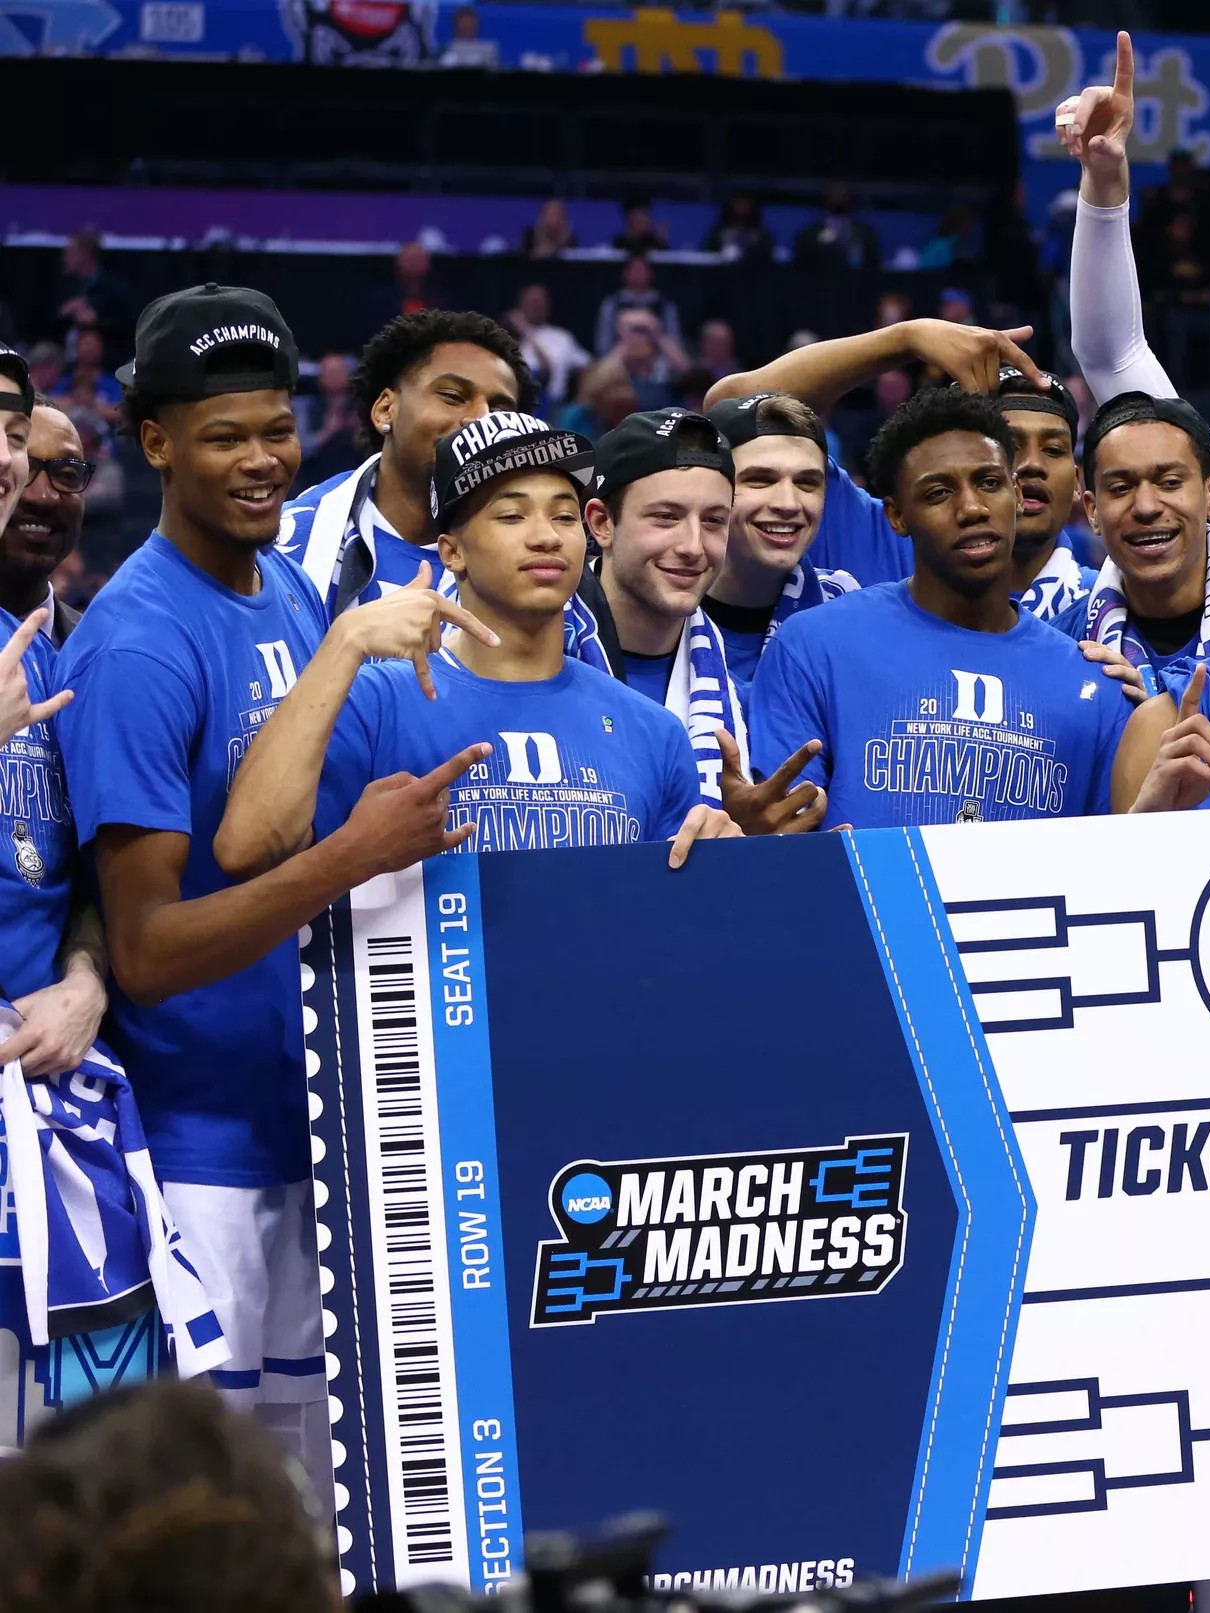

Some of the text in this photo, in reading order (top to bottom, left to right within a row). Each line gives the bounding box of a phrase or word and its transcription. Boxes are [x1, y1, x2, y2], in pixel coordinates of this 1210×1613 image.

[189, 324, 280, 356] ACC CHAMPIONS
[454, 437, 579, 496] CHAMPIONS
[249, 681, 262, 700] 20
[951, 669, 1004, 724] D
[919, 698, 937, 715] 20
[1019, 711, 1034, 729] 19
[906, 722, 926, 734] NEW
[929, 723, 952, 735] YORK
[953, 725, 971, 738] LIFE
[992, 733, 1044, 752] TOURNAMENT
[469, 763, 489, 780] 20
[498, 731, 562, 783] D
[579, 766, 598, 784] 19
[864, 738, 1068, 814] CHAMPIONS
[458, 789, 481, 802] NEW
[483, 787, 508, 800] YORK
[511, 788, 529, 800] LIFE
[553, 789, 613, 805] TOURNAMENT
[438, 892, 473, 1027] SEAT 19
[567, 1196, 612, 1213] NCAA
[616, 1161, 804, 1227] MARCH
[455, 1160, 491, 1290] ROW 19
[643, 1213, 896, 1284] MADNESS
[473, 1418, 502, 1441] 3
